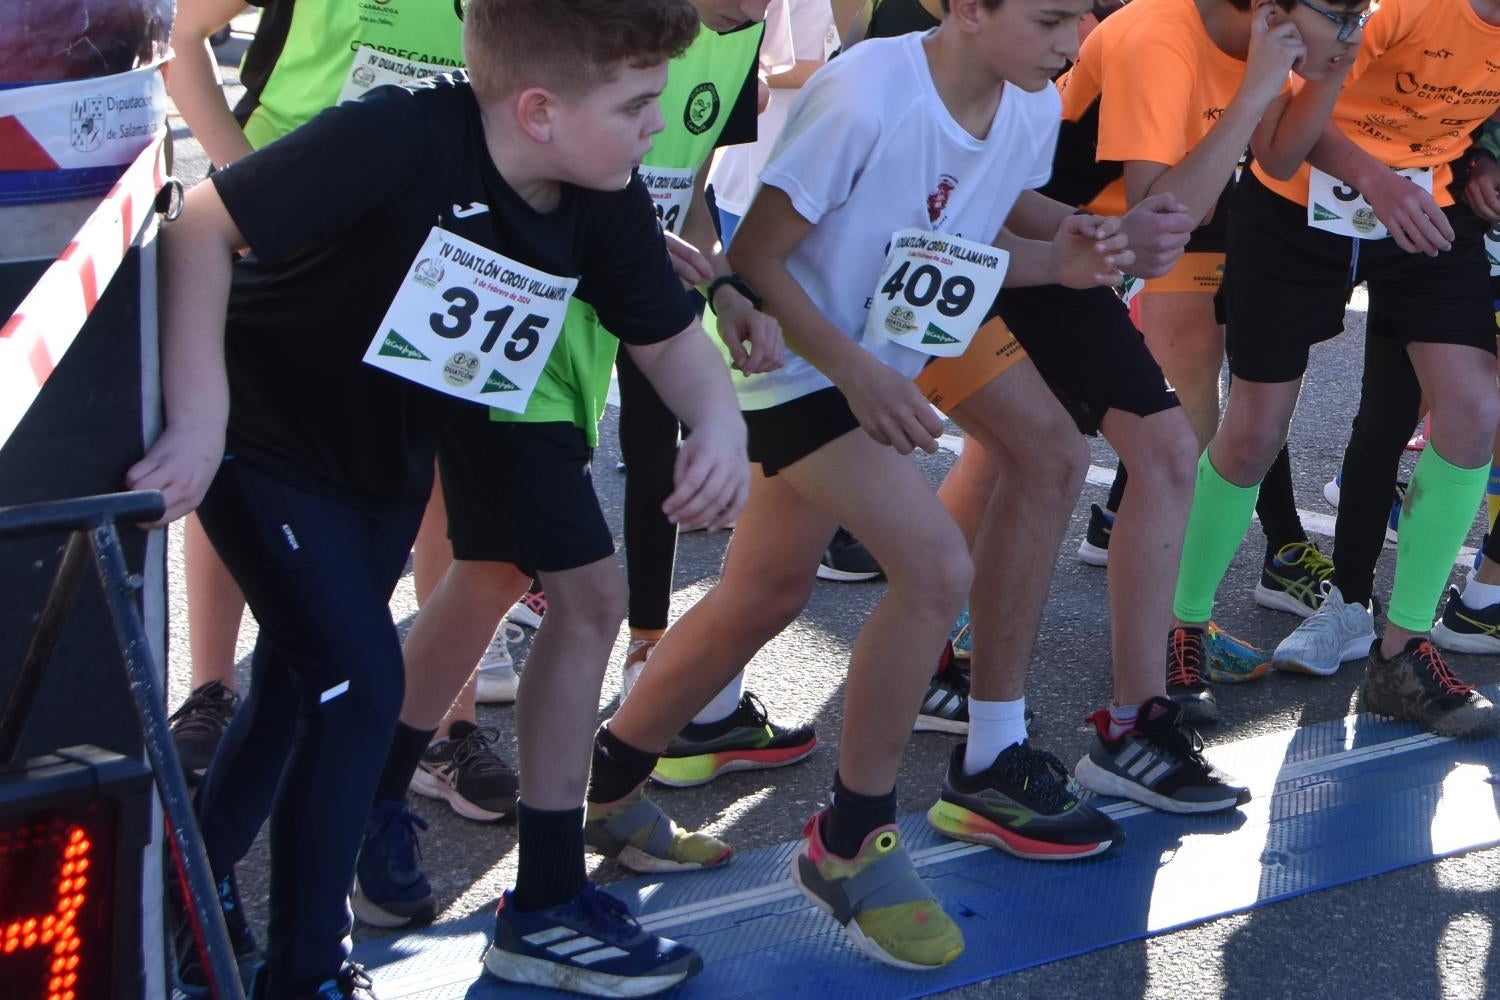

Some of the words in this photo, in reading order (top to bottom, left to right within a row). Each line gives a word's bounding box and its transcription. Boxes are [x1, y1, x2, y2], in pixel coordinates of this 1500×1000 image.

[379, 57, 416, 78] DUATLÓN
[107, 130, 117, 140] de
[439, 242, 454, 259] IV
[451, 247, 502, 280] DUATLÓN
[499, 269, 530, 291] CROSS
[927, 239, 949, 254] CROSS
[949, 243, 999, 270] VILLAMAYOR
[478, 280, 487, 288] de
[487, 283, 509, 298] Febrero
[508, 291, 517, 301] de
[516, 294, 532, 305] 2024
[881, 261, 976, 318] 409
[429, 286, 550, 362] 315
[444, 365, 474, 380] DUATLÓN
